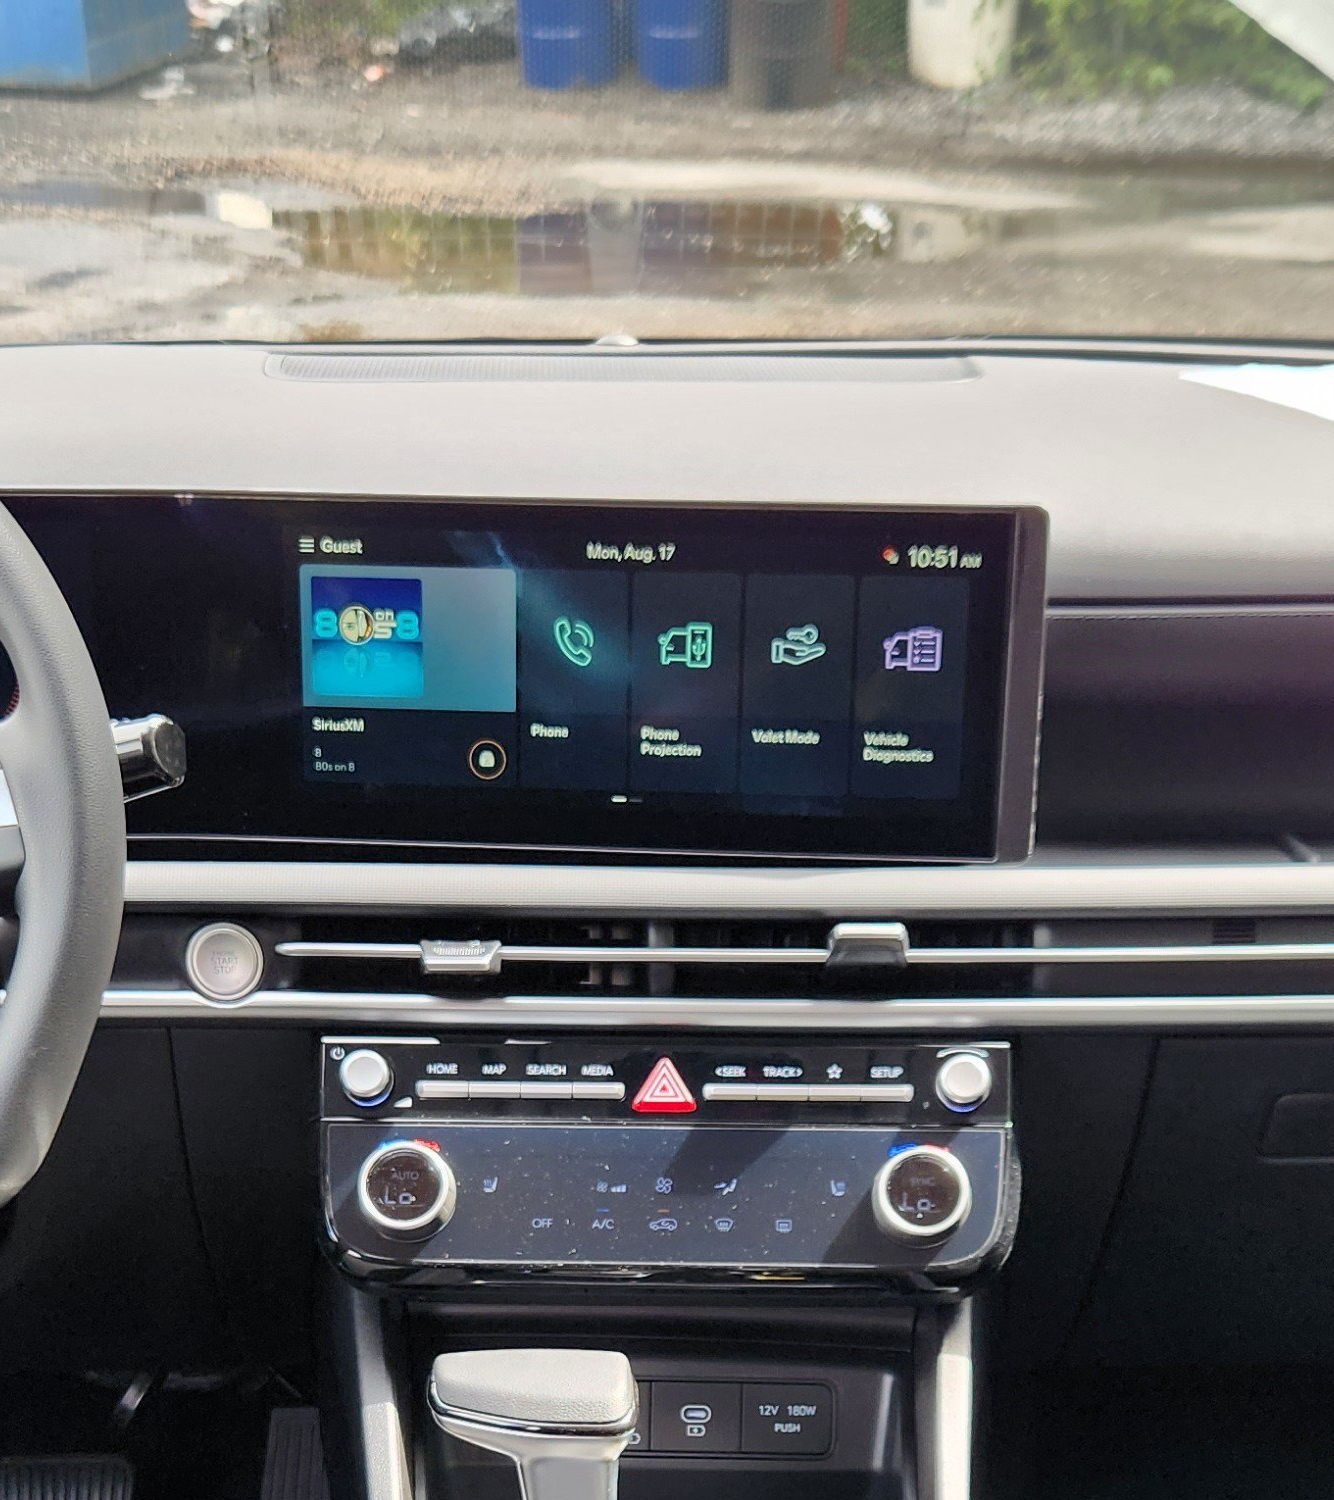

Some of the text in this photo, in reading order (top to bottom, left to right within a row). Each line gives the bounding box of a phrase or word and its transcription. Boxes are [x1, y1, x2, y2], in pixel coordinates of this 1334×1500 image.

[320, 537, 363, 554] Guest
[586, 542, 676, 564] Mon, Aug. 17
[907, 545, 983, 568] 10:51 AM
[312, 717, 365, 732] SiriusXM
[530, 723, 569, 738] Phone
[640, 726, 680, 741] Phone
[751, 729, 821, 745] Valet Mode
[864, 732, 910, 746] Vehicle
[640, 741, 702, 757] Projection
[863, 747, 934, 764] Diagnostics
[315, 761, 333, 771] 80s
[348, 762, 355, 772] 8
[426, 1063, 458, 1075] HOME
[482, 1063, 507, 1075] MAP
[525, 1064, 567, 1076] SEARCH
[581, 1065, 614, 1077] MEDIA
[870, 1066, 904, 1078] SETUP
[391, 1171, 420, 1180] AUTO
[532, 1218, 554, 1229] OFF
[591, 1219, 616, 1230] A/C
[758, 1404, 817, 1416] 12V 180W
[774, 1422, 801, 1433] PUSH
